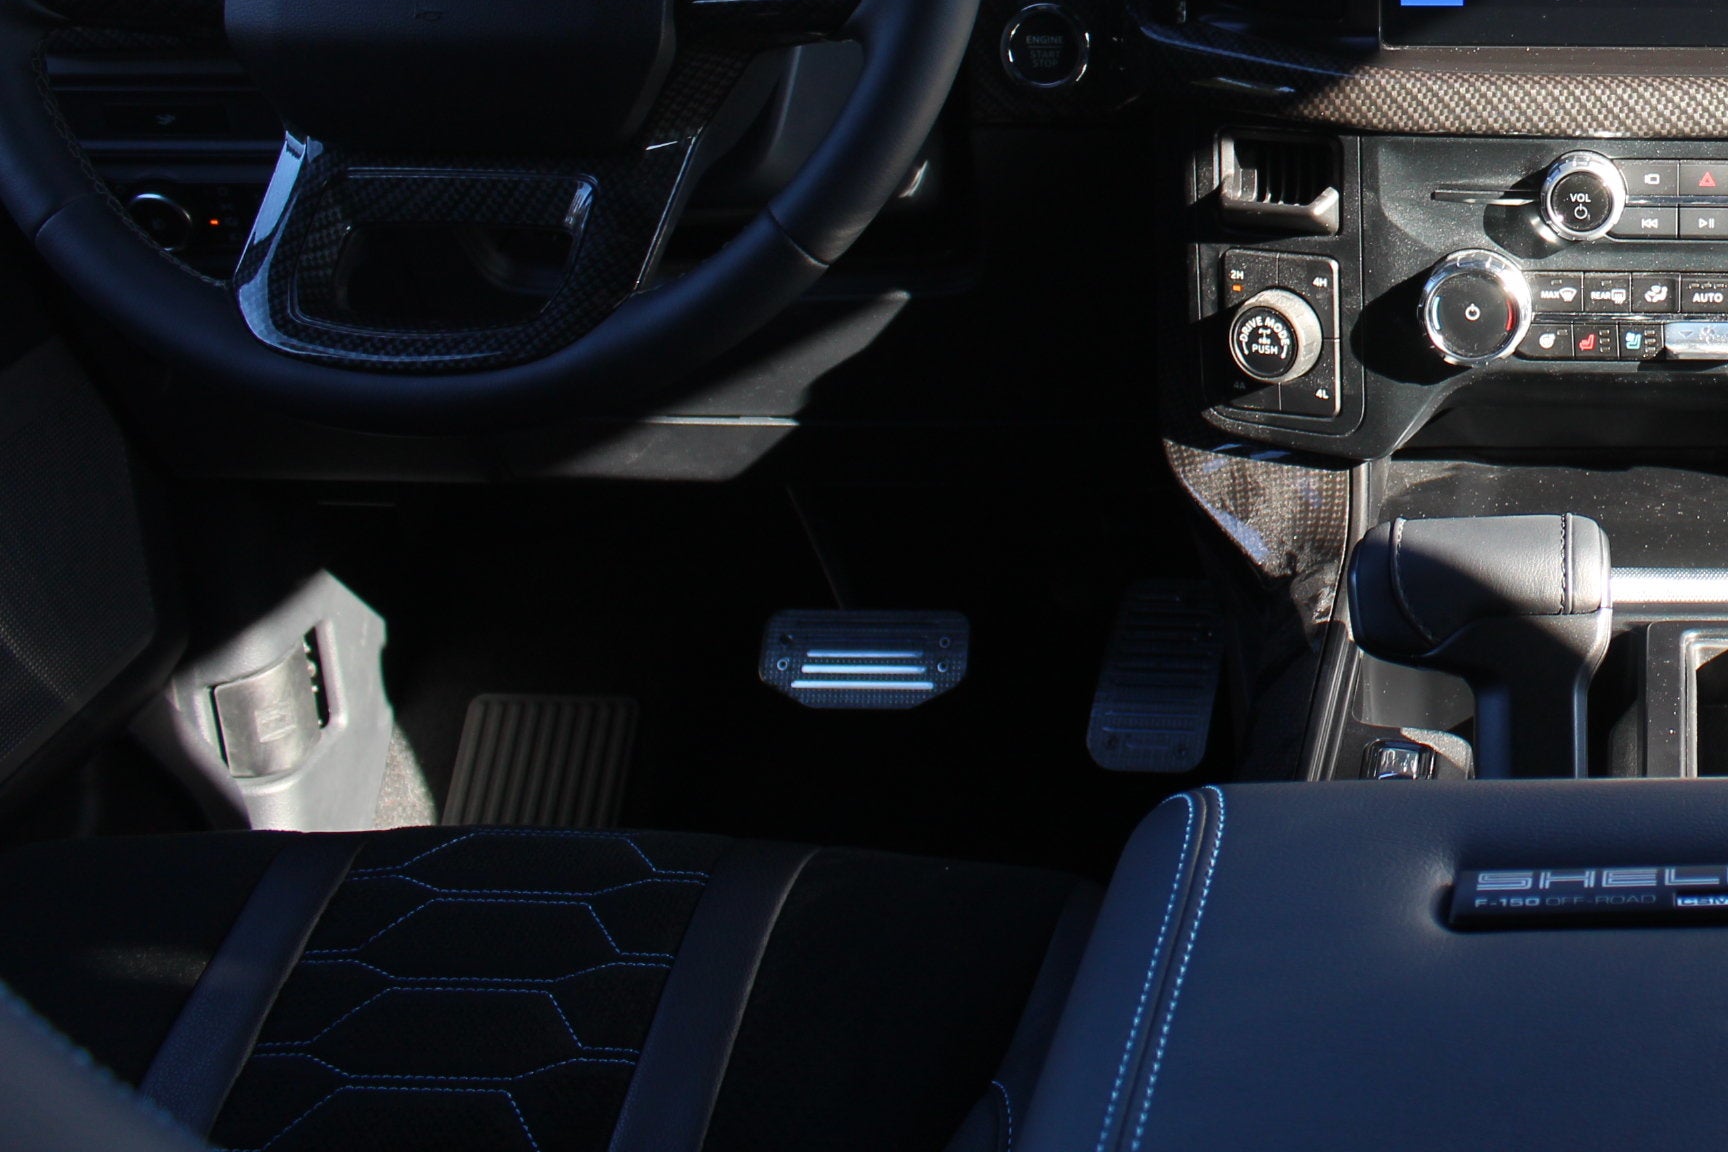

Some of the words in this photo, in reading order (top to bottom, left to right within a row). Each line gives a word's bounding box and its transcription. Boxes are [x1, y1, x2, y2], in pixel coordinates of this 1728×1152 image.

[1025, 35, 1064, 45] ENGINE
[1030, 50, 1061, 59] START
[1032, 59, 1059, 68] STOP
[1569, 193, 1592, 203] VOL
[1230, 270, 1244, 280] 2H
[1312, 277, 1328, 288] 4H
[1540, 290, 1560, 299] MAX
[1591, 291, 1611, 300] REAR
[1692, 292, 1724, 303] AUTO
[1239, 316, 1264, 342] DRIVE
[1264, 317, 1291, 346] MODE
[1252, 344, 1278, 355] PUSH
[1315, 388, 1330, 400] 4L
[1474, 896, 1540, 908] F-150
[1545, 894, 1656, 906] OFF-ROAD
